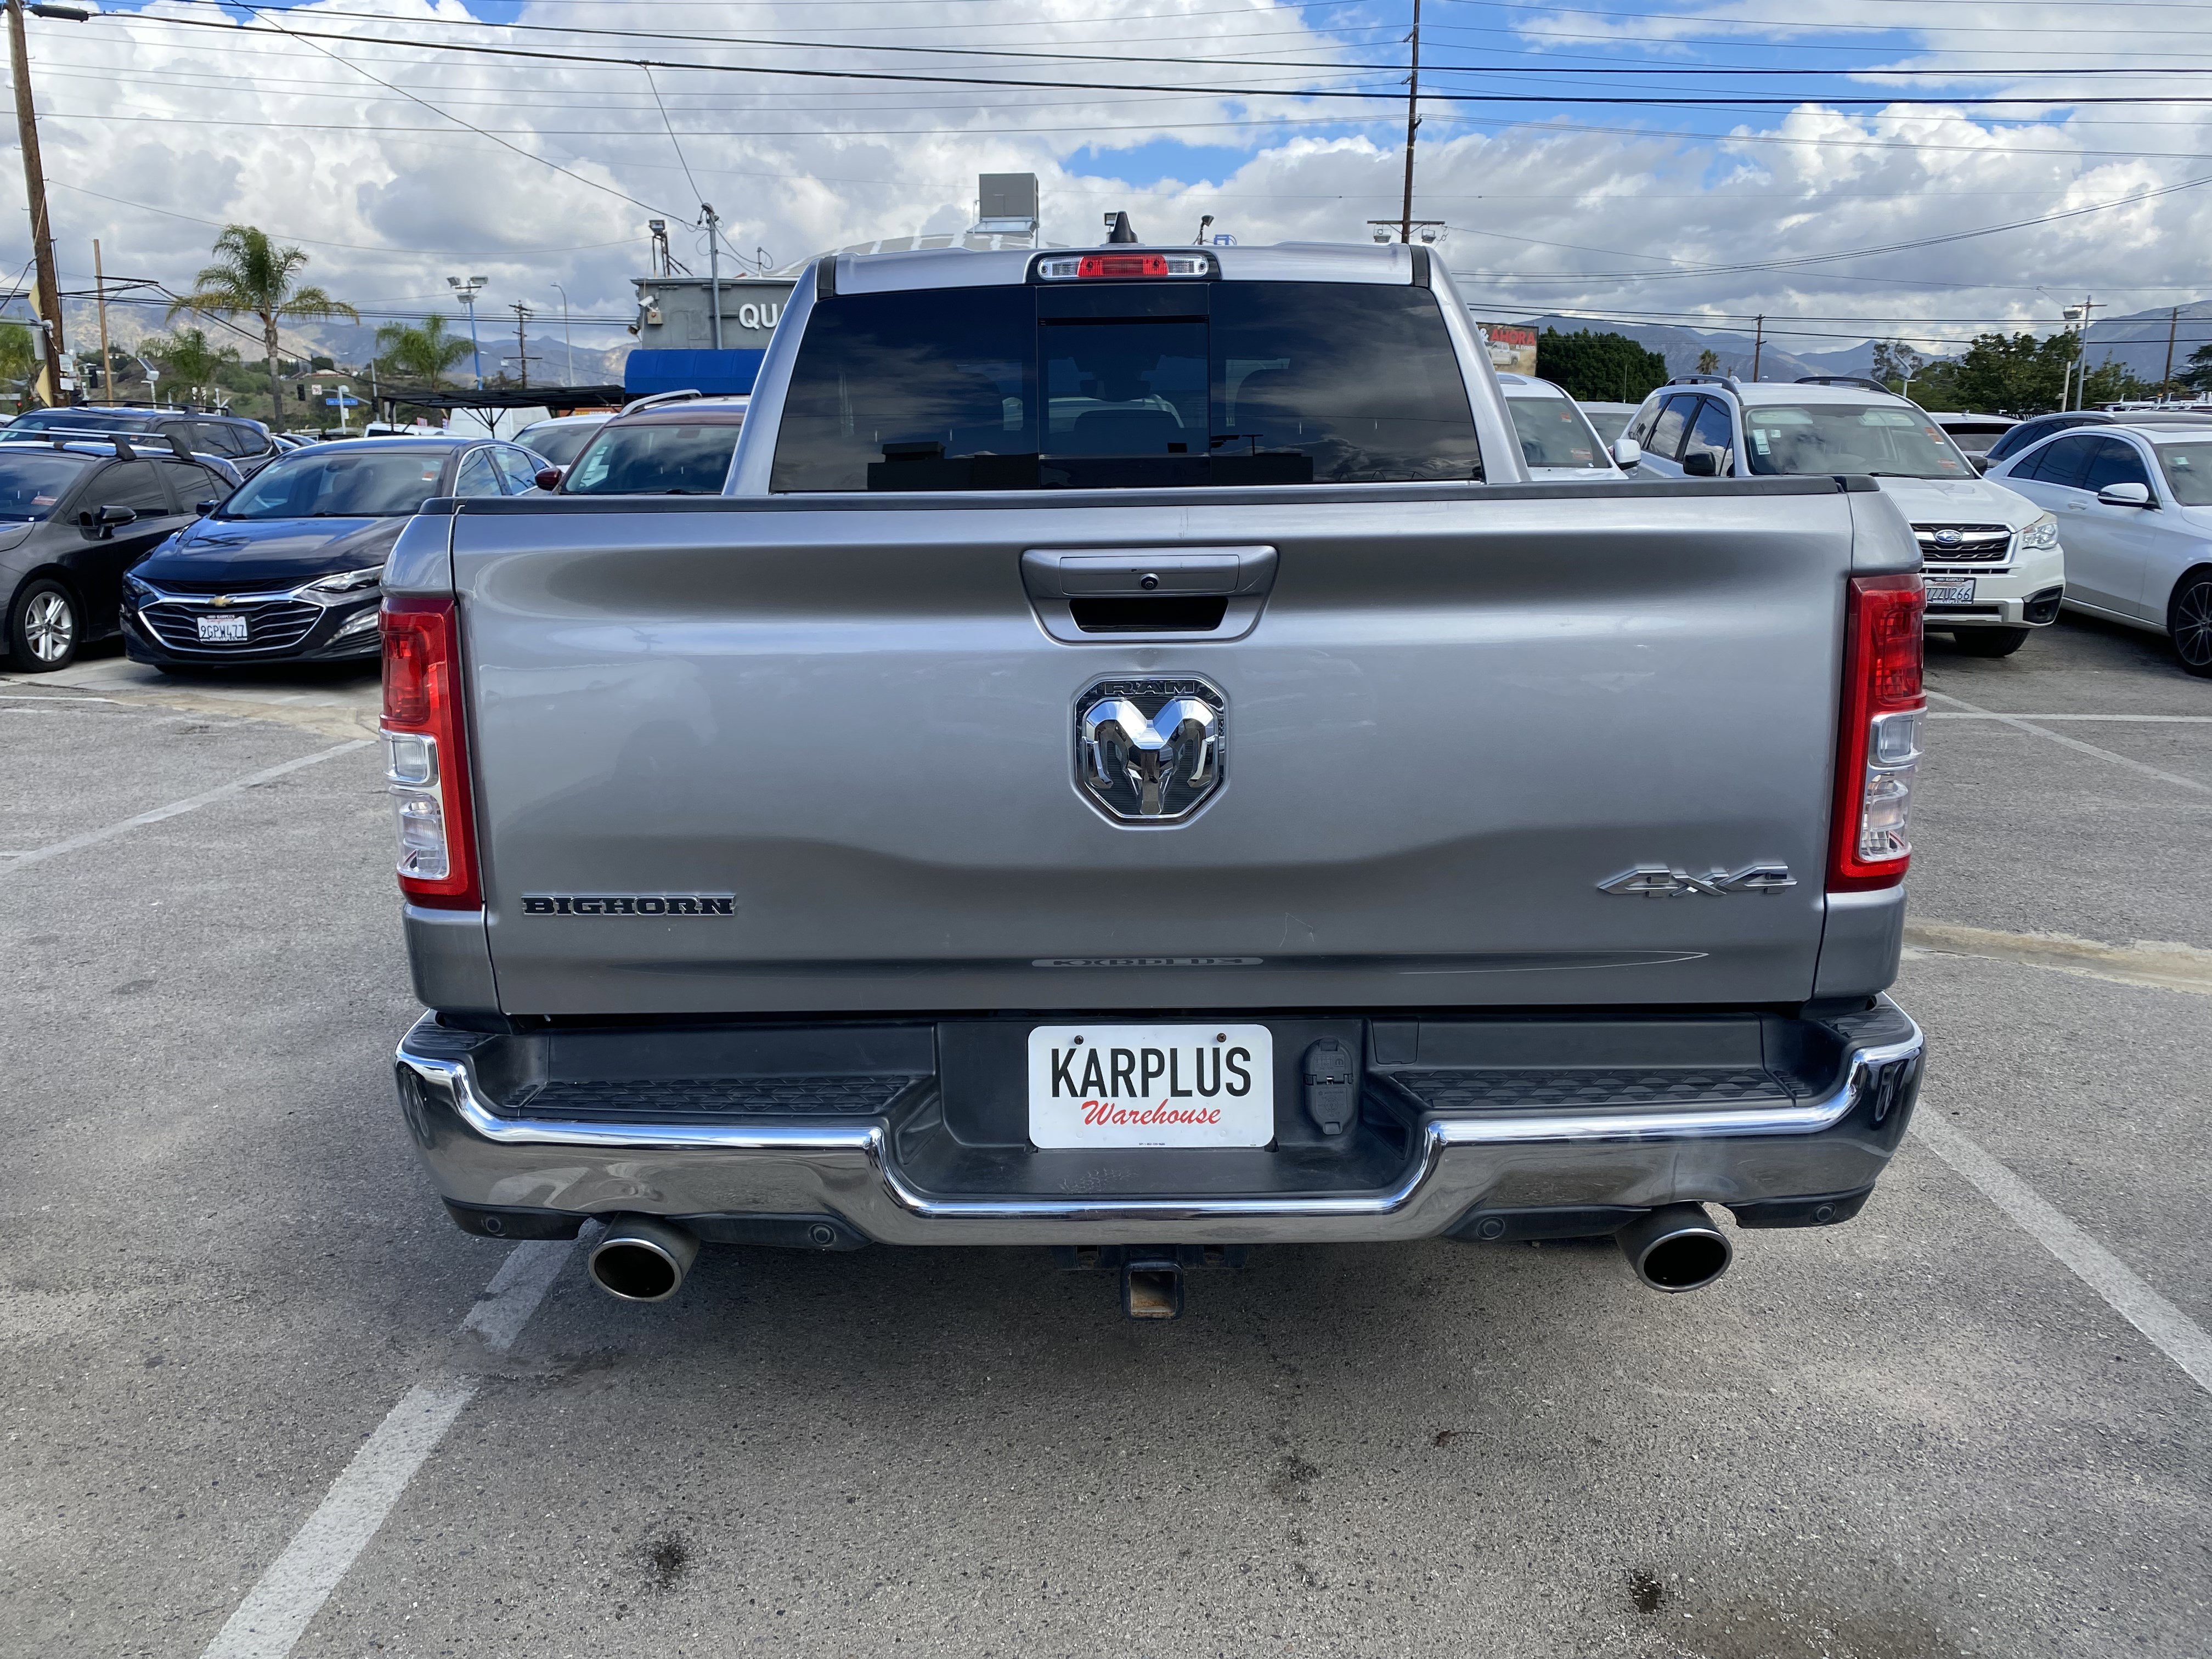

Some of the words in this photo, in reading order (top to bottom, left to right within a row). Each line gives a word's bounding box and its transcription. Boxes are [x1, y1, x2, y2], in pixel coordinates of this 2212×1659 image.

[739, 303, 787, 330] QU
[1491, 329, 1536, 346] AHORA
[200, 624, 244, 638] 9GPW477
[1104, 681, 1195, 696] RAM
[521, 895, 736, 916] BIGHORN
[1051, 1046, 1251, 1098] KARPLUS
[1081, 1098, 1221, 1126] Warehouse
